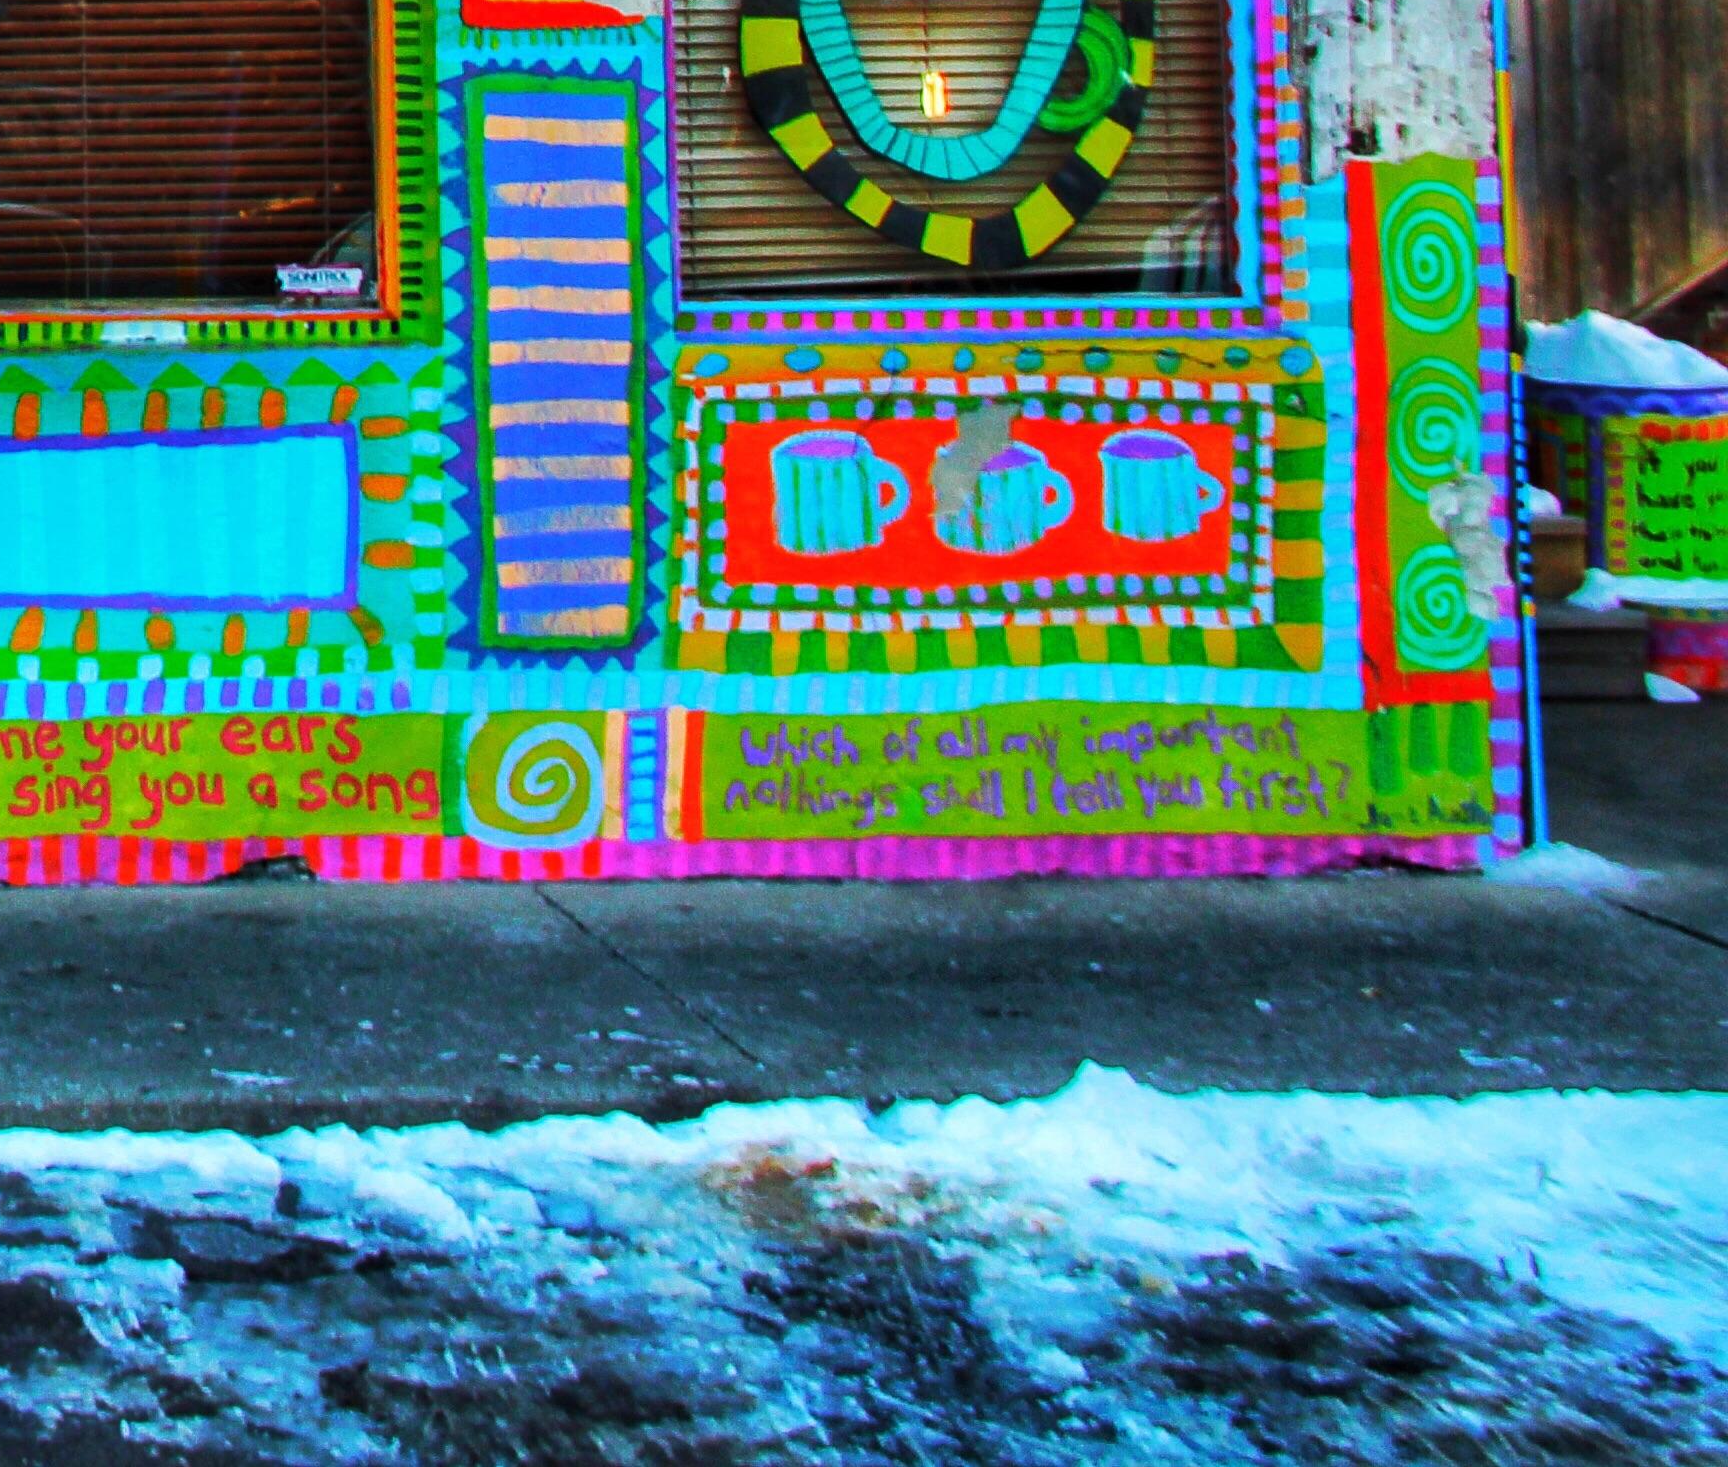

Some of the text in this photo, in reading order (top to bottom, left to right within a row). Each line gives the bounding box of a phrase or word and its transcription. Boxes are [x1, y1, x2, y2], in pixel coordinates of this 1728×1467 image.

[80, 718, 193, 773] your
[219, 714, 362, 765] ears
[740, 706, 1302, 769] Which of all my important
[7, 762, 113, 831] sing
[130, 770, 226, 830] you
[247, 772, 279, 809] a
[297, 767, 442, 821] song
[724, 771, 897, 830] nothings
[1023, 767, 1039, 816] I
[1051, 768, 1125, 818] tell
[1136, 770, 1205, 819] you
